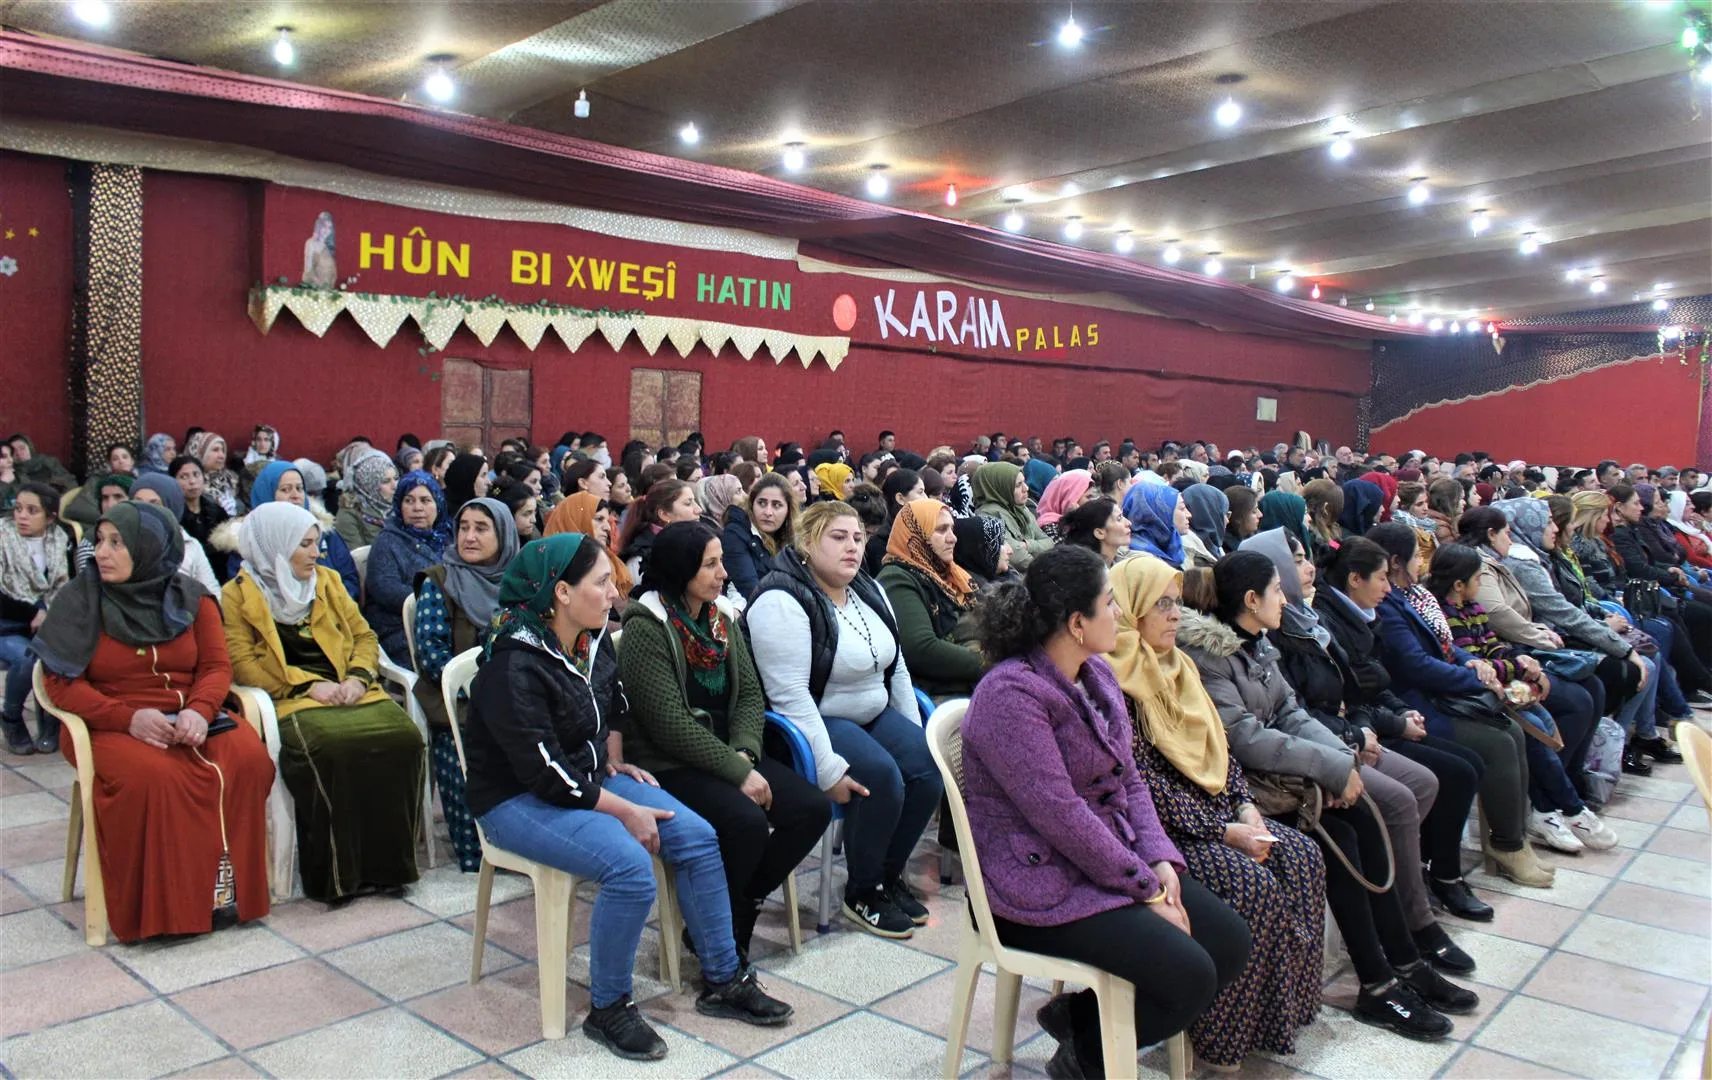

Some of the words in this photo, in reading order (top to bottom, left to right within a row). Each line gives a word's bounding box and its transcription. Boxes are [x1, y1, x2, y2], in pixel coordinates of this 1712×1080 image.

[359, 226, 471, 278] HÛN
[511, 250, 552, 286] BI
[566, 255, 677, 301] XWEŞÎ
[697, 273, 791, 310] HATIN
[874, 288, 1011, 349] KARAM
[1015, 323, 1099, 351] PALAS
[855, 902, 880, 926] FILA
